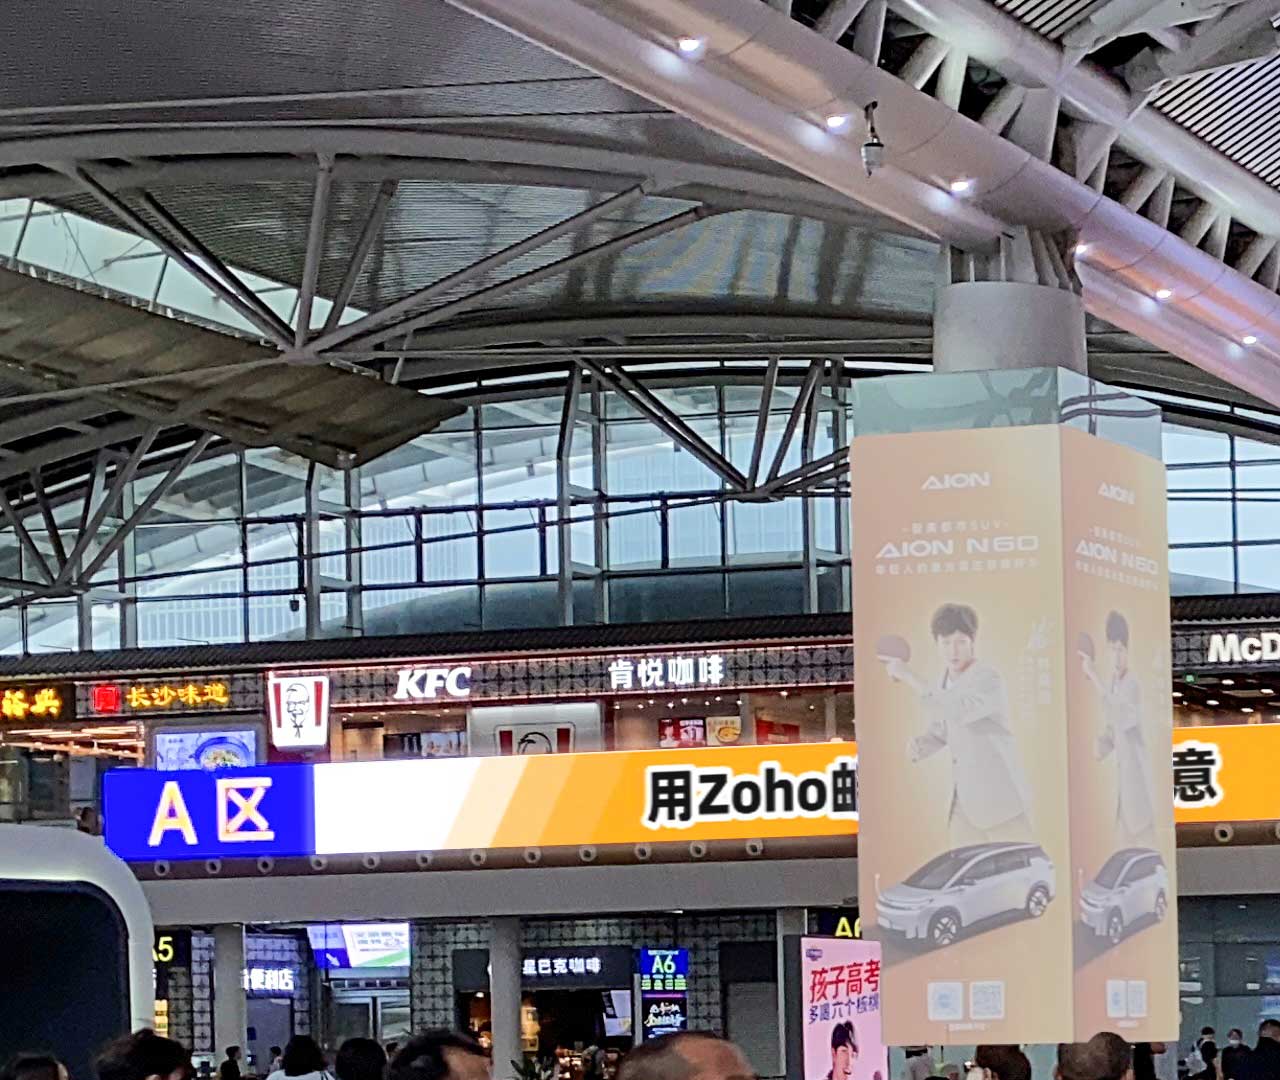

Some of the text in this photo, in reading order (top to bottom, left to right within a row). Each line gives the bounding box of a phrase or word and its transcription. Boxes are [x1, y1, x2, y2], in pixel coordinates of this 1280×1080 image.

[921, 471, 990, 490] AION
[1098, 481, 1136, 504] AION
[875, 540, 953, 559] AION
[1076, 539, 1117, 564] AION
[394, 666, 472, 700] KFC
[608, 654, 725, 690] 肯悦咖啡
[126, 682, 229, 709] 长沙味道
[523, 957, 601, 975] 星巴克咖啡
[652, 955, 676, 974] A6
[810, 959, 880, 1004] 孩子高考
